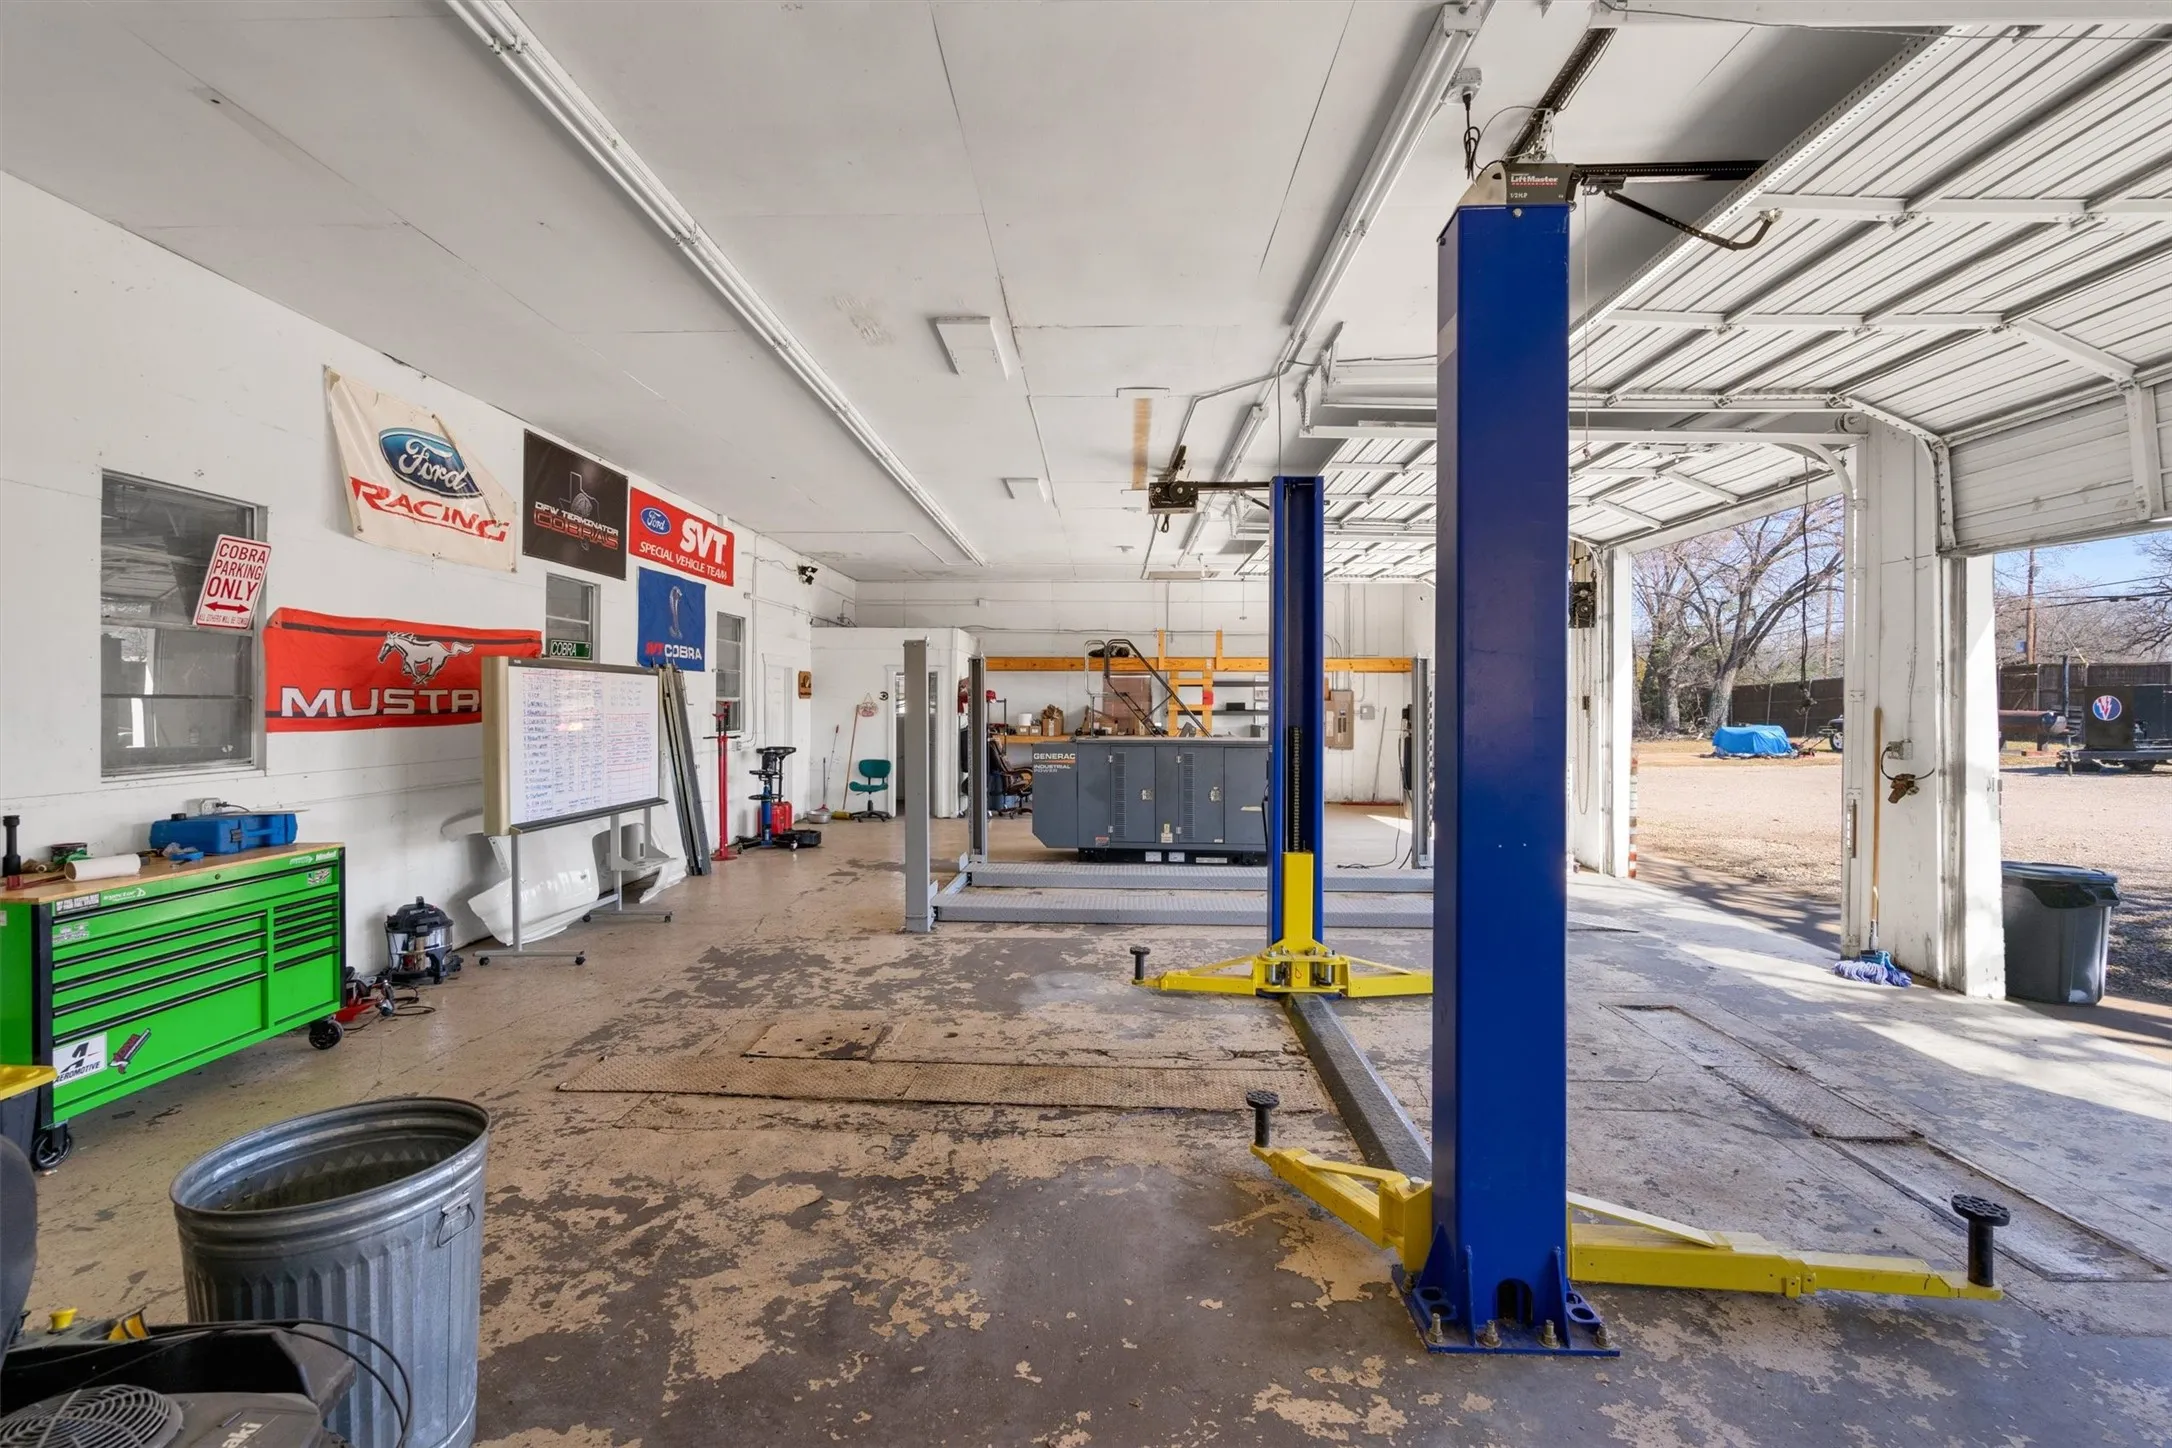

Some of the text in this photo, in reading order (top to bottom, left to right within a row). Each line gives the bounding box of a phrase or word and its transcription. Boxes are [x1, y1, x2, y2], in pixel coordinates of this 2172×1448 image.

[399, 438, 469, 491] Ford
[350, 476, 510, 542] RACING
[535, 501, 619, 536] DFW TERMINATOR
[646, 510, 667, 531] Ford
[534, 509, 619, 550] COBRAS
[680, 518, 727, 565] SVT
[219, 543, 267, 564] COBRA
[639, 541, 728, 581] SPECIAL VEHICLE TEAM
[213, 559, 263, 580] PARKING
[206, 576, 259, 601] ONLY
[552, 641, 577, 656] COBRA
[664, 644, 703, 660] COBRA
[1033, 752, 1076, 760] GENERAC
